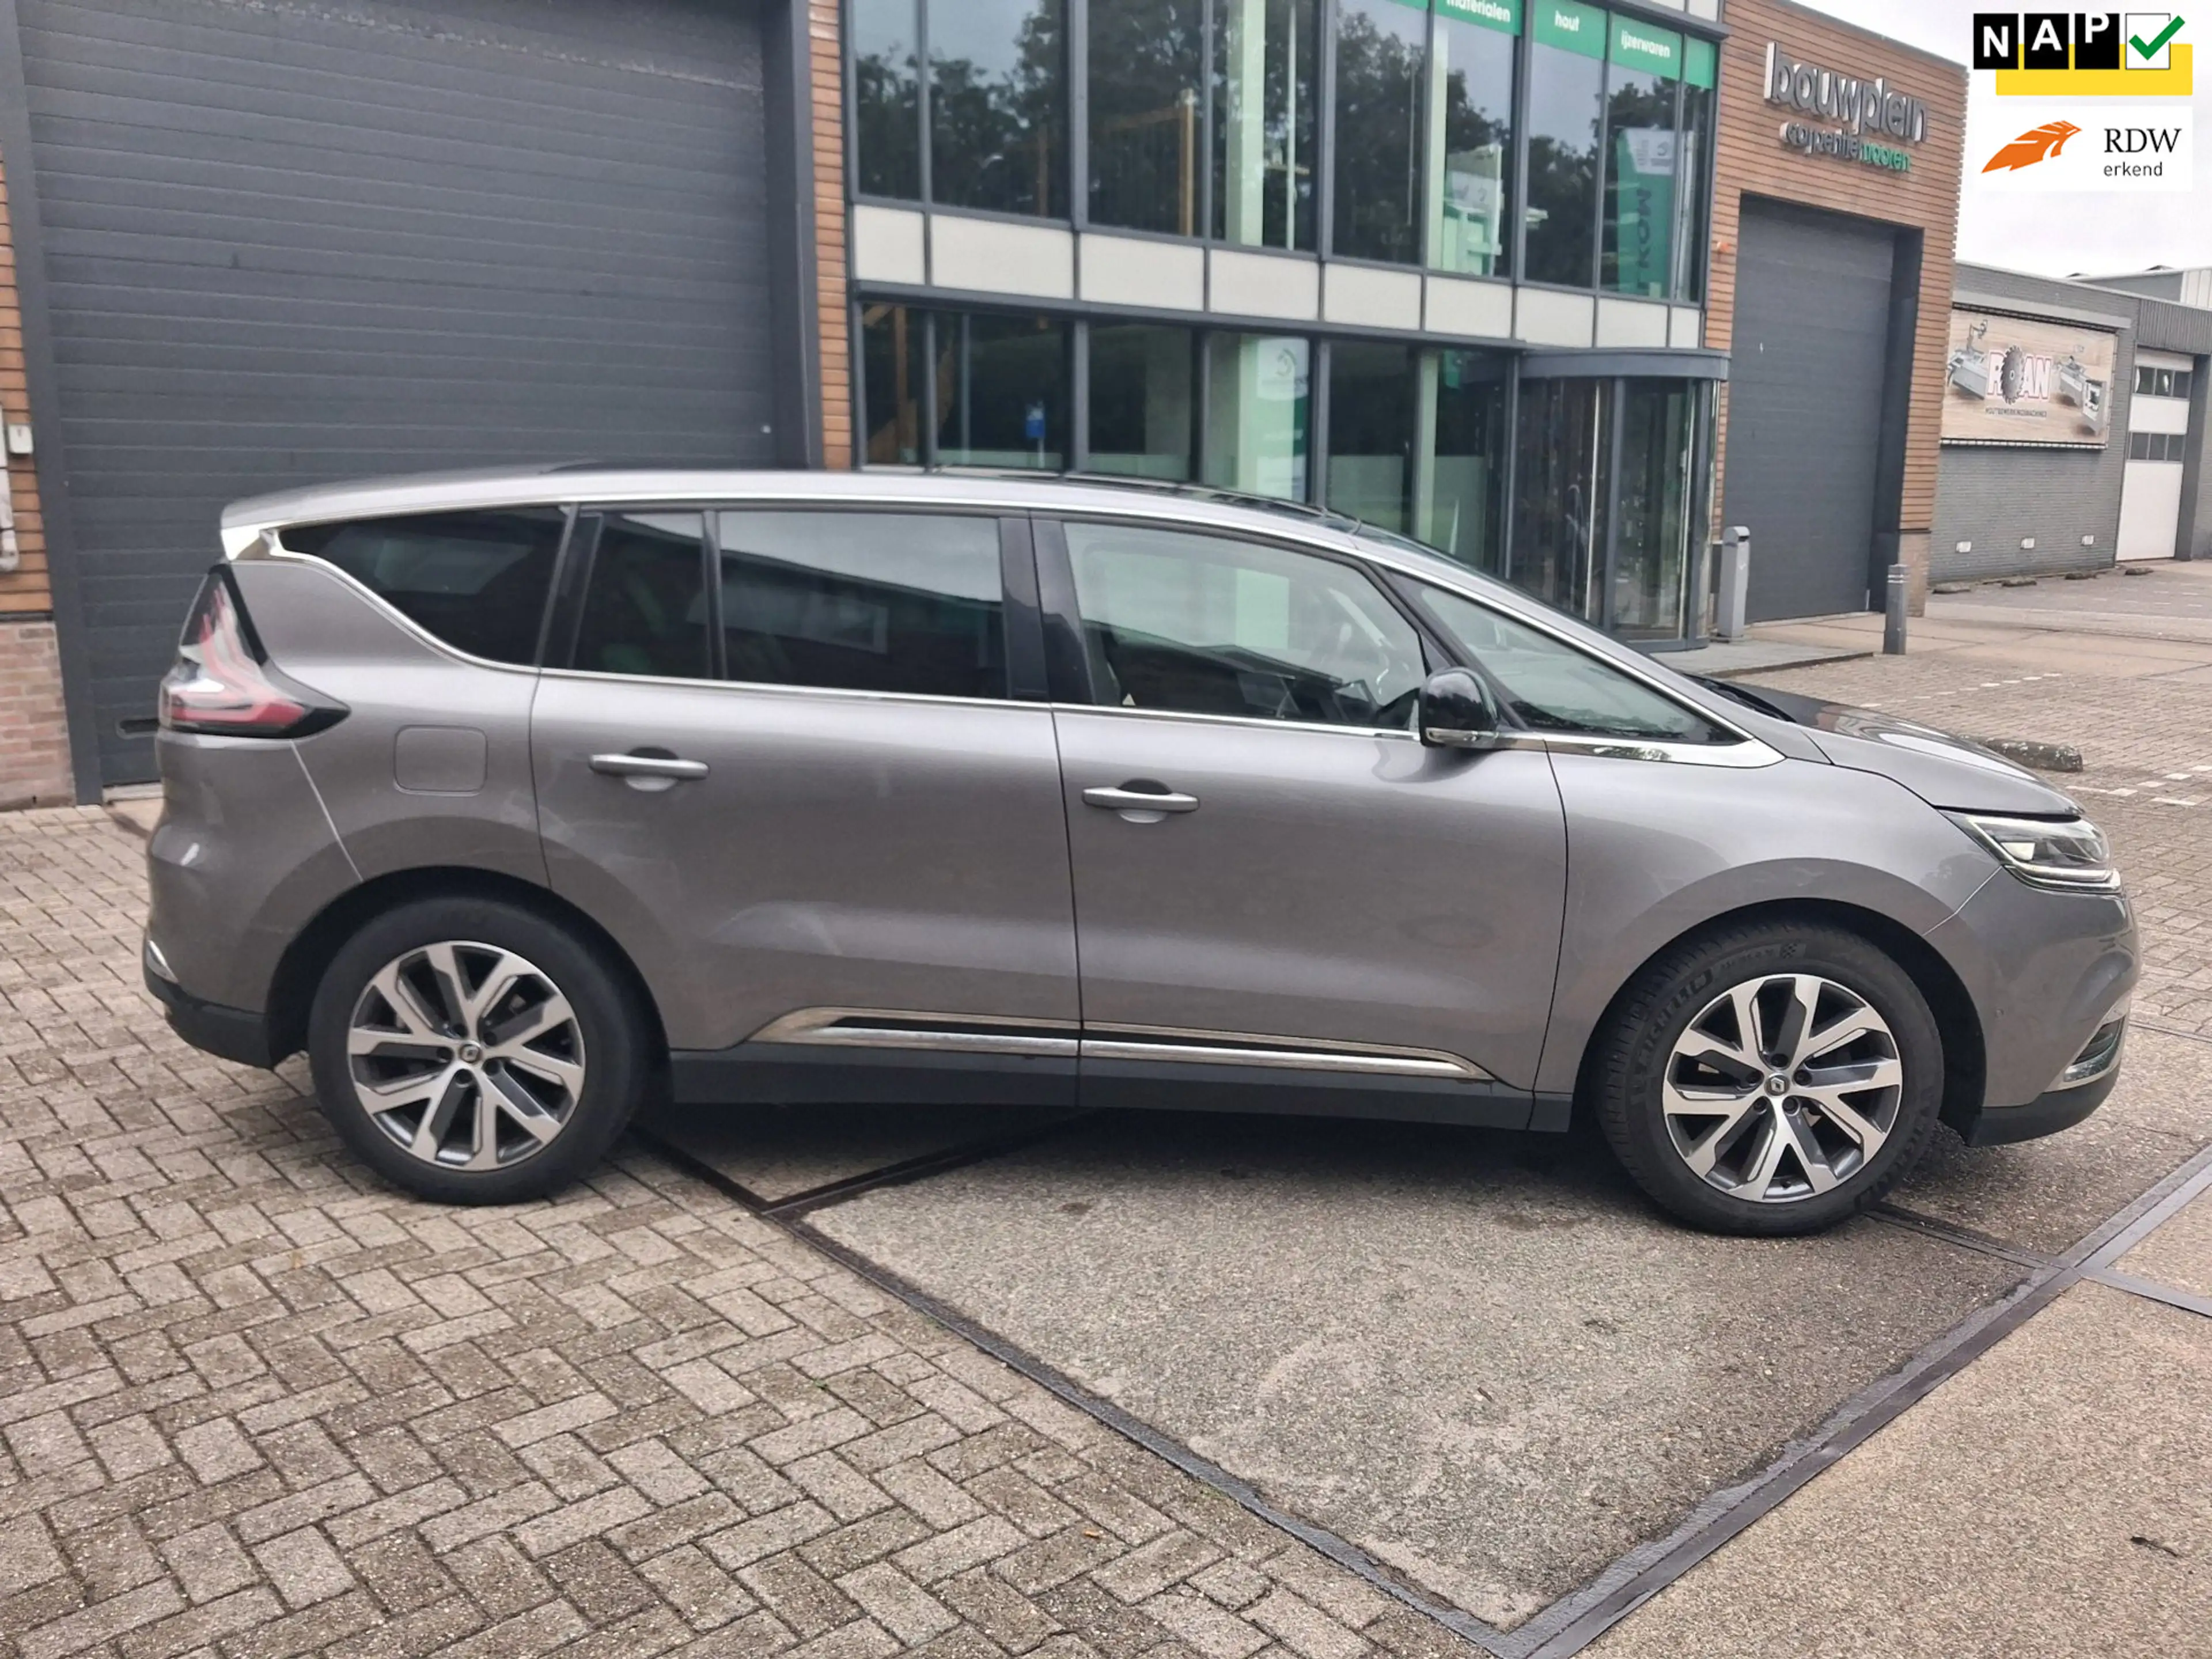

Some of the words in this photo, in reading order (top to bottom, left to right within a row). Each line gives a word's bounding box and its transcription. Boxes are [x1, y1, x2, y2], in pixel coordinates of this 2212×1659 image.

[1446, 0, 1511, 22] materialen
[1555, 10, 1580, 32] hout
[1621, 29, 1671, 58] ijzerwaren
[1763, 41, 1929, 143] bouwplein
